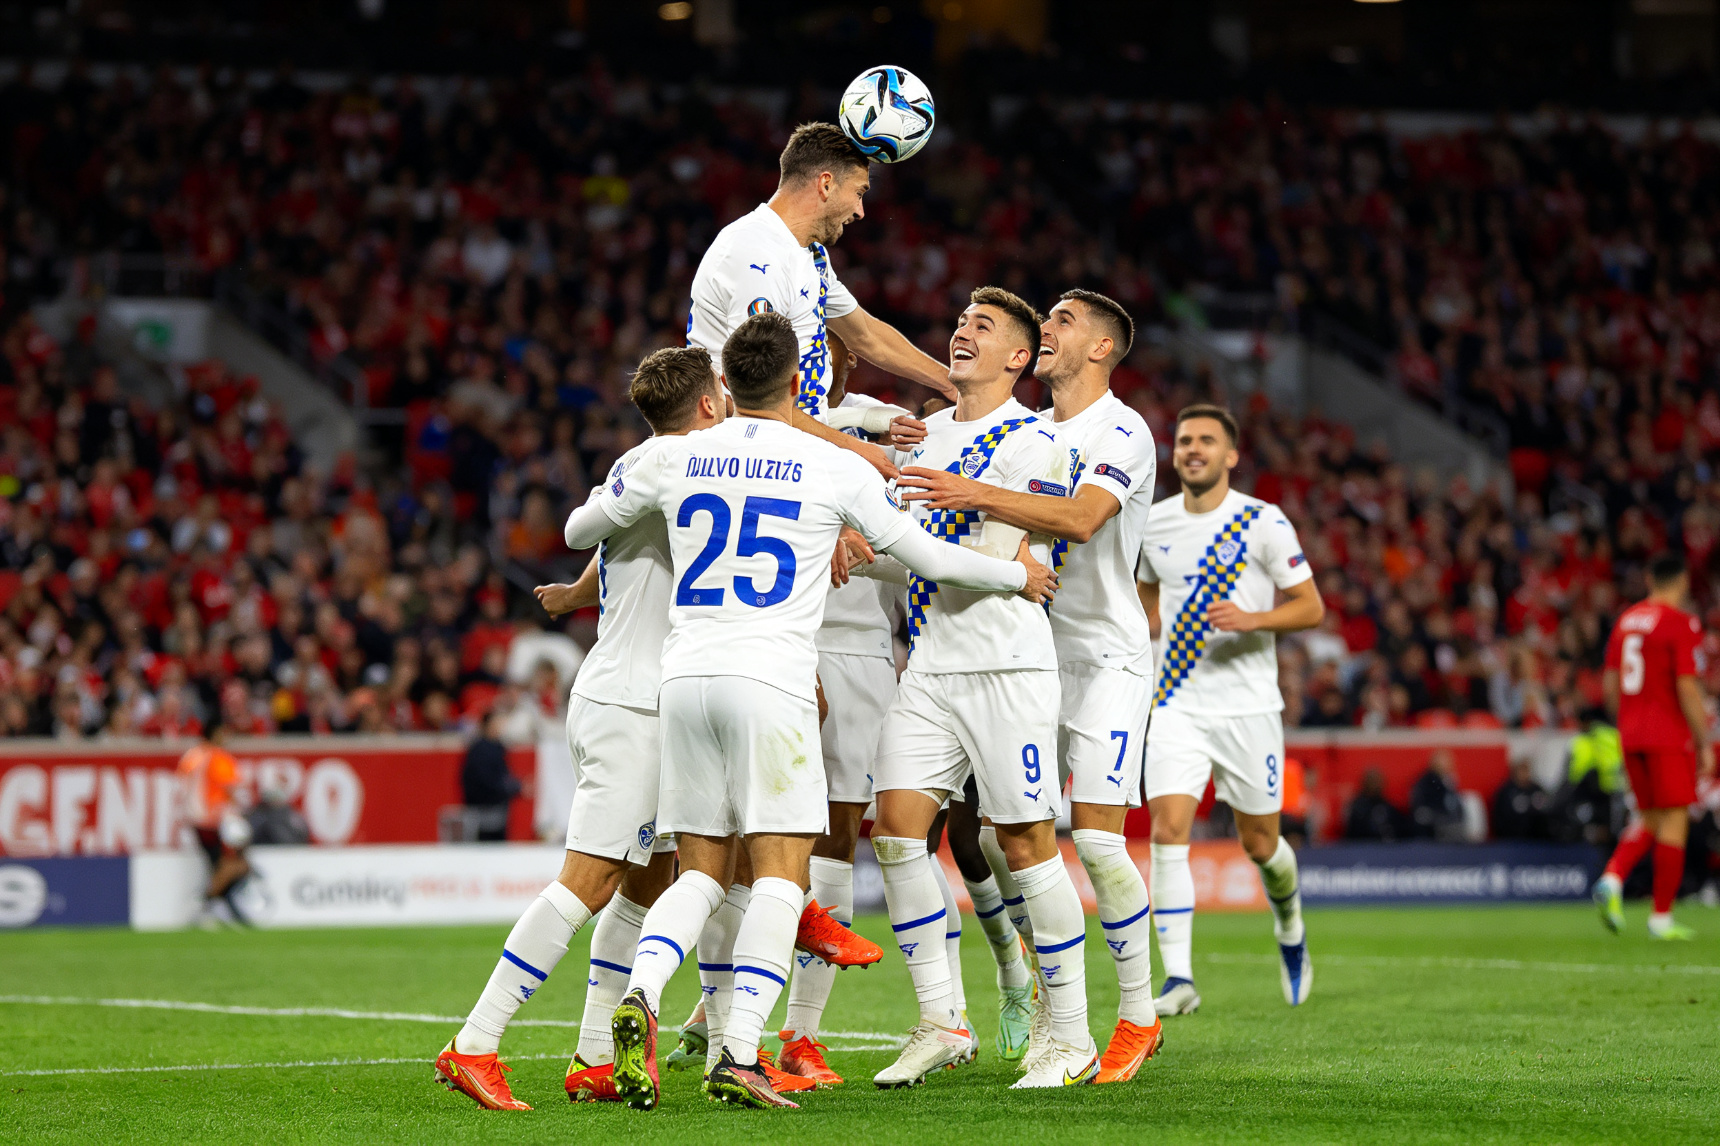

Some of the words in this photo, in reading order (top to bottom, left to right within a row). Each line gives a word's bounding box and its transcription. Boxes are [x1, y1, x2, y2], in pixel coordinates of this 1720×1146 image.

[676, 492, 802, 608] 25
[1021, 743, 1041, 784] 9
[1110, 730, 1129, 771] 7
[1265, 753, 1279, 788] 8
